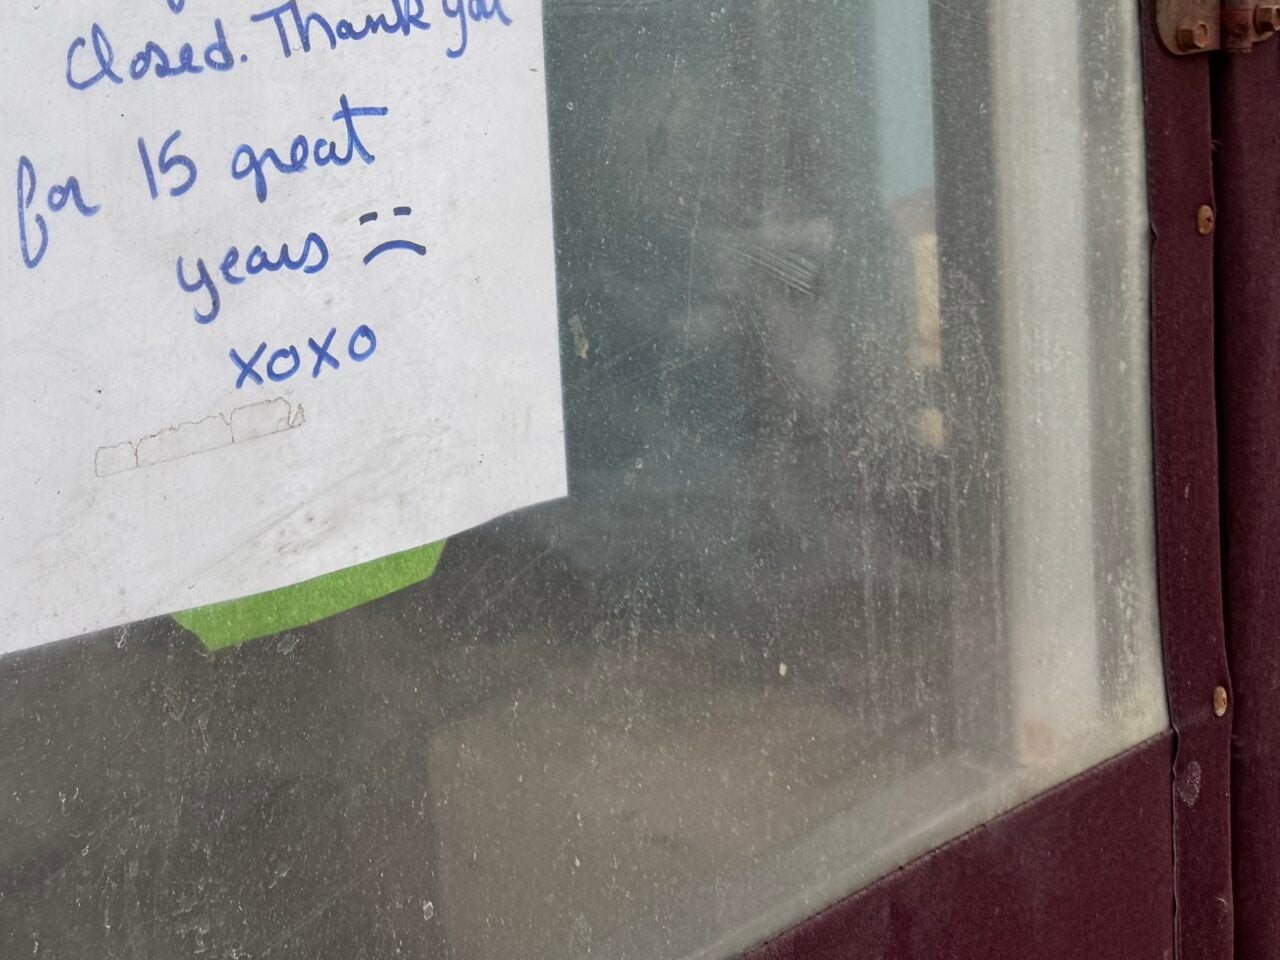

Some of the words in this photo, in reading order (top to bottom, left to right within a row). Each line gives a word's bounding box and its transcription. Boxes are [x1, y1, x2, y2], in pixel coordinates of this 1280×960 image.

[17, 155, 101, 269] for
[137, 129, 198, 200] 15
[231, 93, 389, 203] great
[176, 232, 330, 324] years
